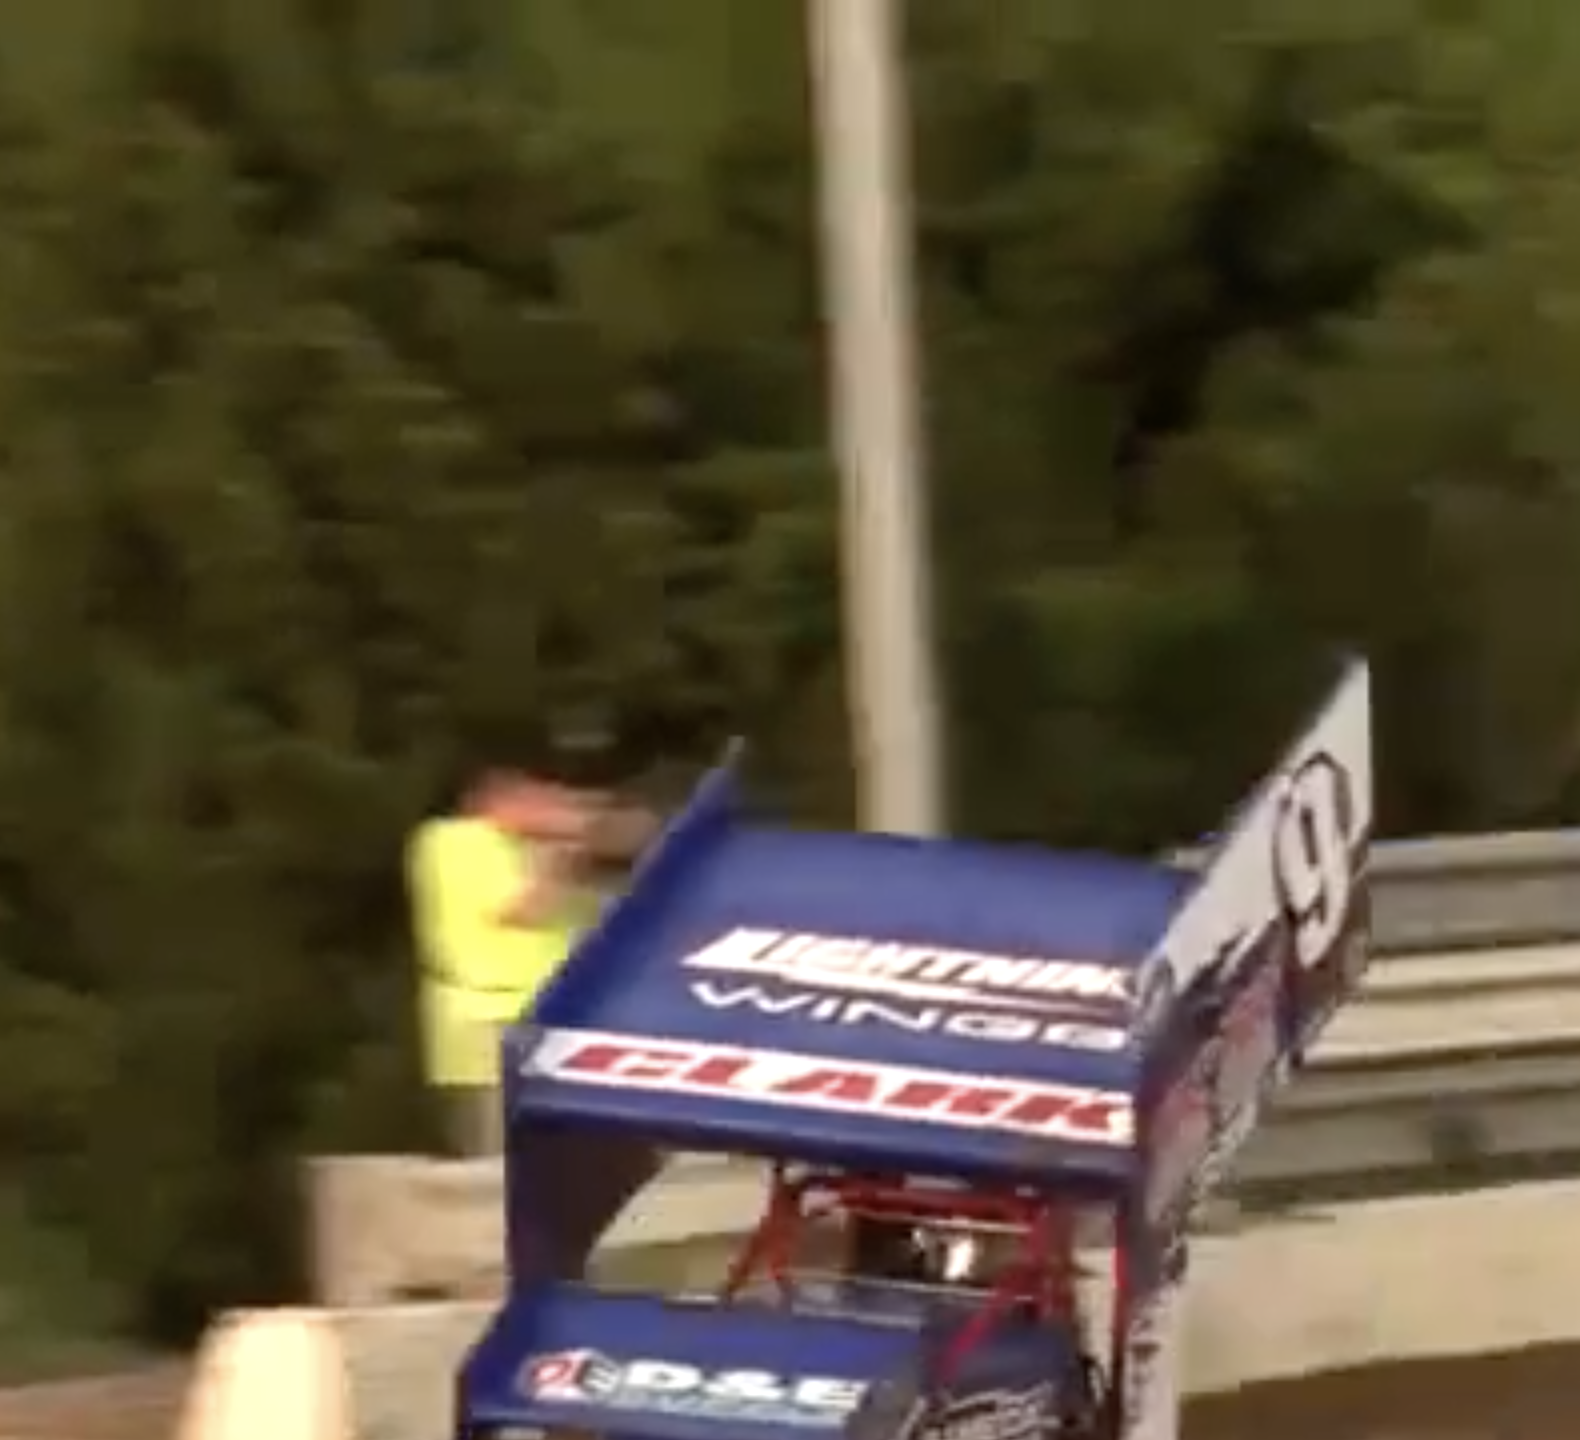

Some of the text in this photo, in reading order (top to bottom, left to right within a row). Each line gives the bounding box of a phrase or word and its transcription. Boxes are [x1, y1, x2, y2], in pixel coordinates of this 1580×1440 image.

[1271, 750, 1352, 968] 9
[688, 980, 1128, 1050] WINGS
[560, 1043, 1117, 1131] CLARK
